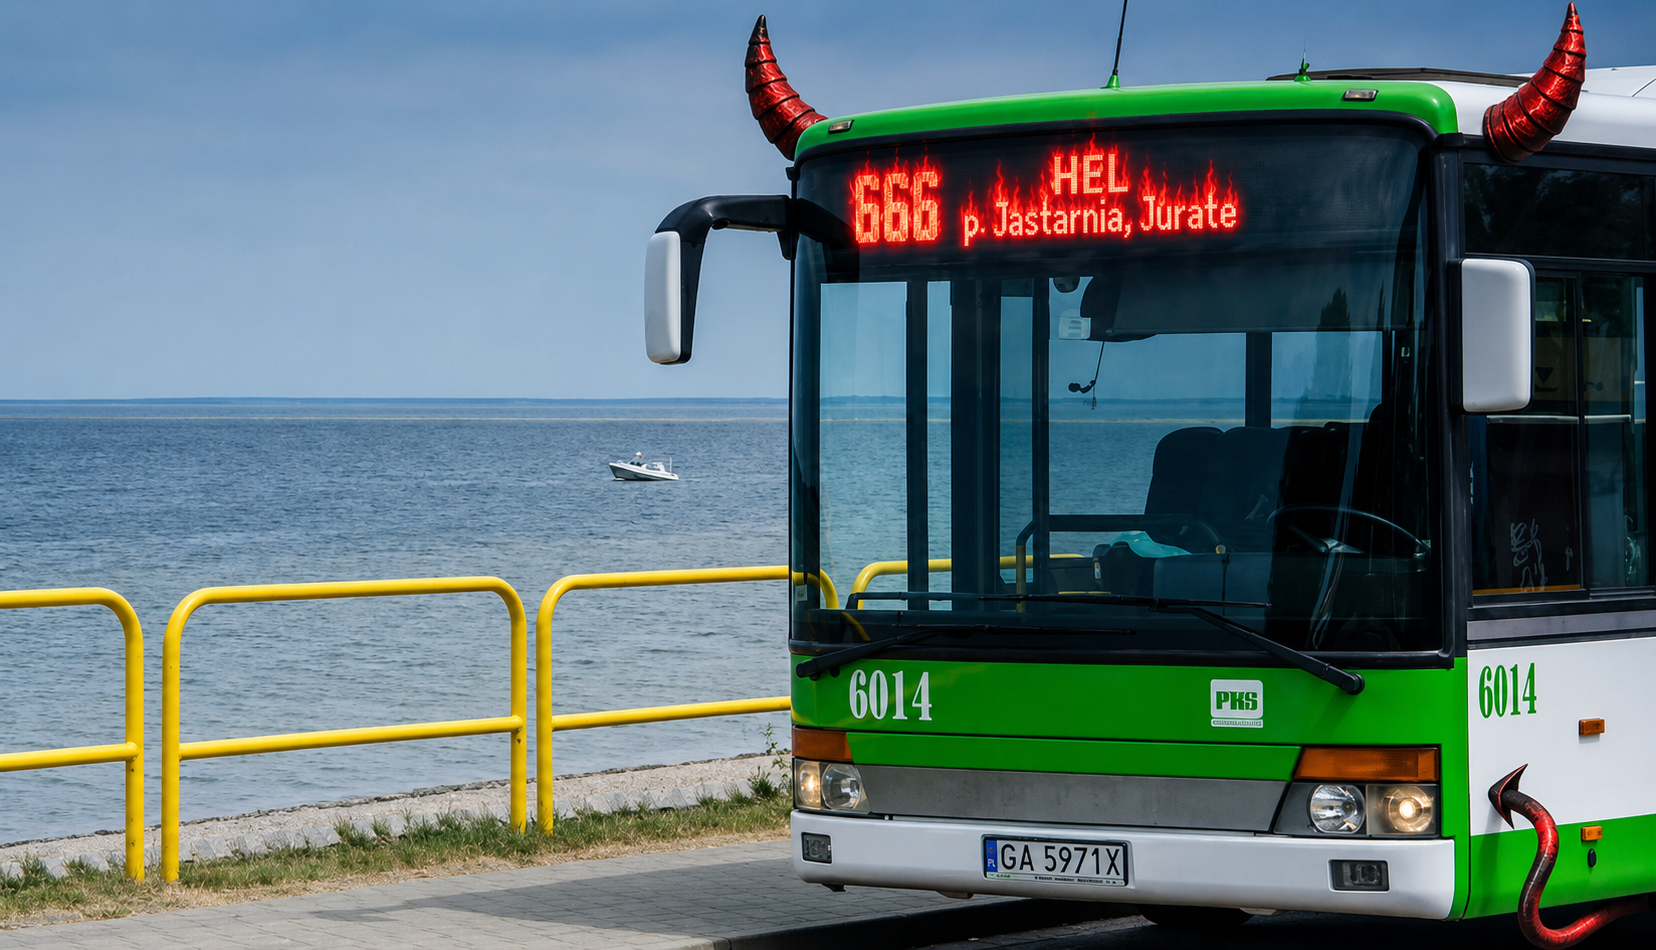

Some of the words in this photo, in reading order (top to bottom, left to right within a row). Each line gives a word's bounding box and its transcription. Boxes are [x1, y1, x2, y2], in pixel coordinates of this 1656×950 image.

[1054, 153, 1128, 195] HEL
[855, 171, 938, 243] 666
[964, 215, 985, 246] p.
[993, 199, 1132, 238] Jastarnia,
[1140, 191, 1237, 231] Jurate
[849, 669, 932, 721] 6014
[1216, 690, 1258, 711] PKS
[1478, 662, 1537, 719] 6014
[1000, 843, 1035, 872] GA
[1044, 845, 1121, 877] 5971X
